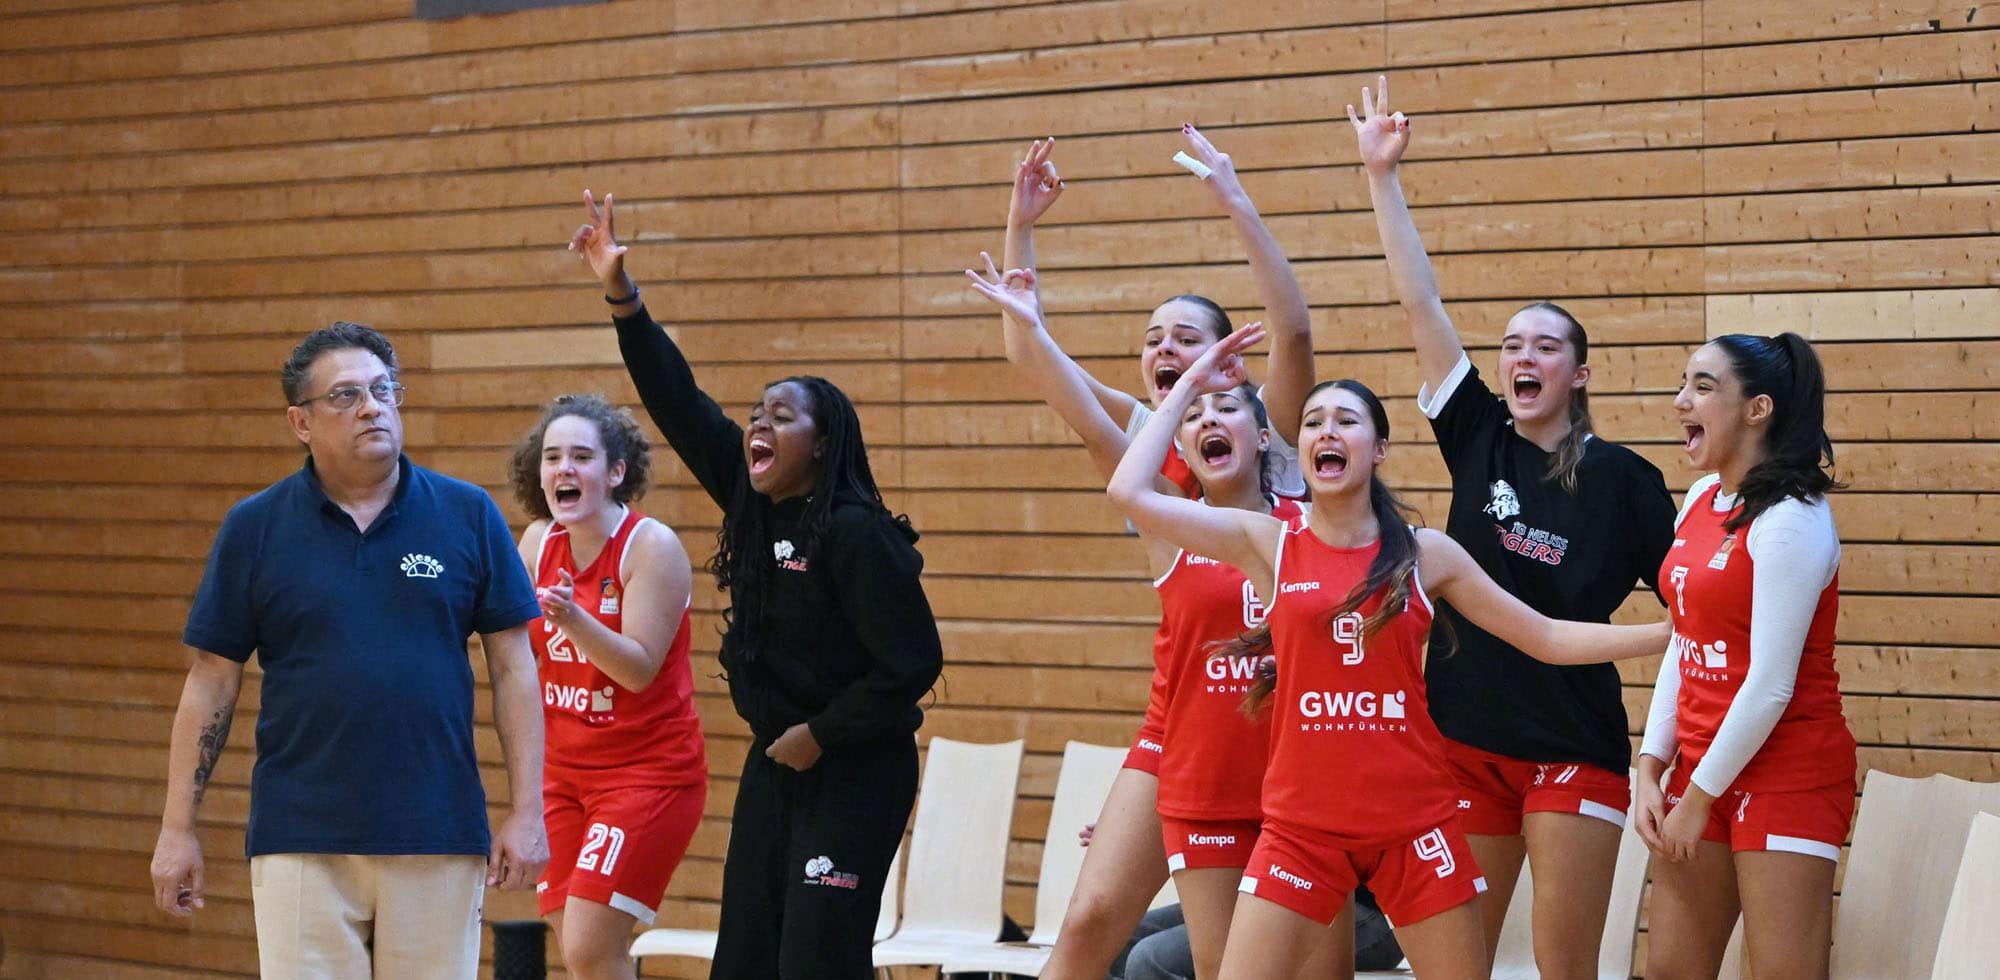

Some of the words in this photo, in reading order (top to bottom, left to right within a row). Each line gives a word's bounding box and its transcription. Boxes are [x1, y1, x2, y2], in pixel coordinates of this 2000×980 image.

[1527, 528, 1568, 550] NEUSS
[1280, 581, 1320, 594] Kempa
[1671, 566, 1689, 616] 7
[1332, 611, 1365, 666] 9
[1673, 633, 1702, 666] WG
[545, 681, 589, 711] GWG
[1299, 691, 1377, 718] GWG
[1301, 722, 1407, 732] WOHNFÜHLEN
[1138, 738, 1163, 753] Kem
[576, 822, 625, 876] 21
[1188, 833, 1236, 847] Kempa
[1413, 827, 1456, 879] 9
[1269, 864, 1313, 891] Kempa
